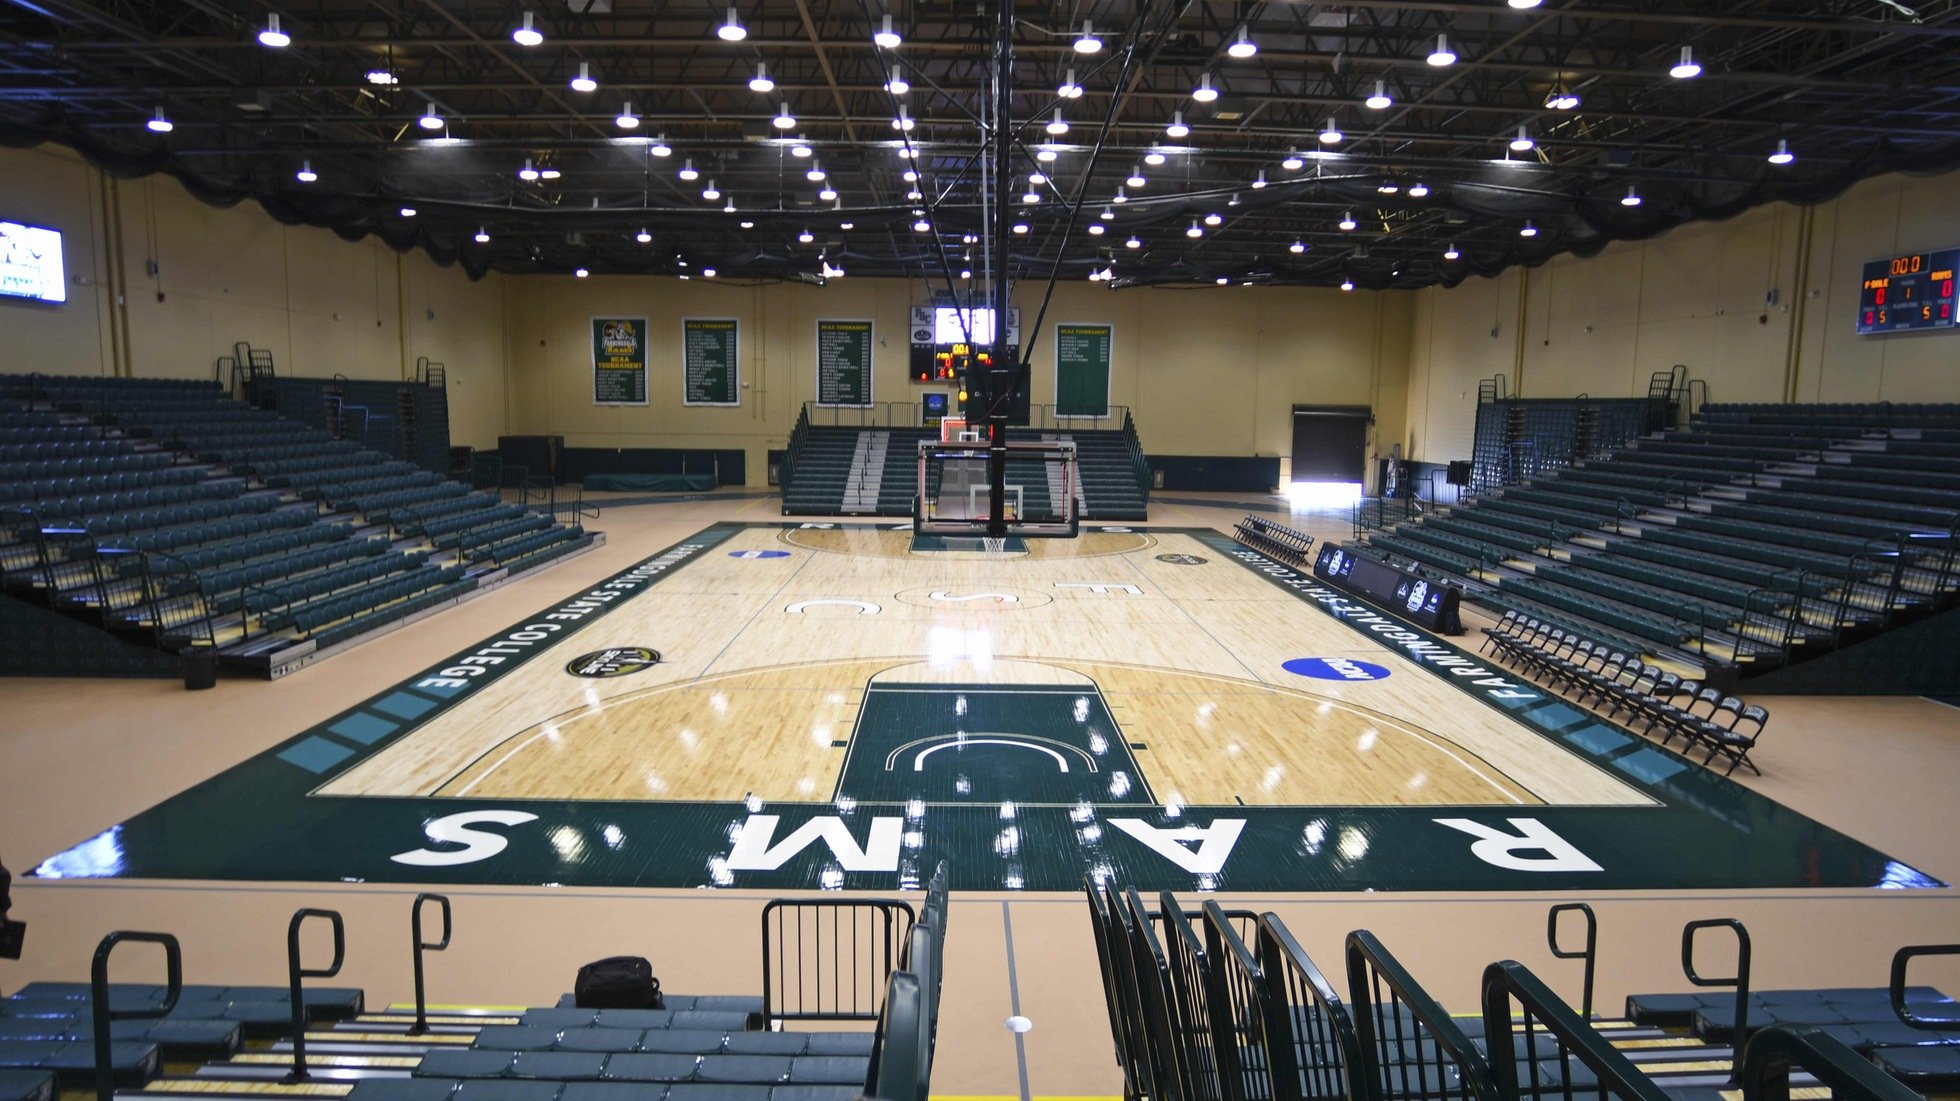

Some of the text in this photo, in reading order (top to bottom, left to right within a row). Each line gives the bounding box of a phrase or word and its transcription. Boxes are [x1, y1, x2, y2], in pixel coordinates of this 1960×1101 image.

[1876, 288, 1885, 305] 0
[1942, 280, 1952, 297] 0
[545, 590, 621, 620] STATE
[416, 623, 562, 688] COLLEGE
[1332, 605, 1539, 699] FARMINGDALE
